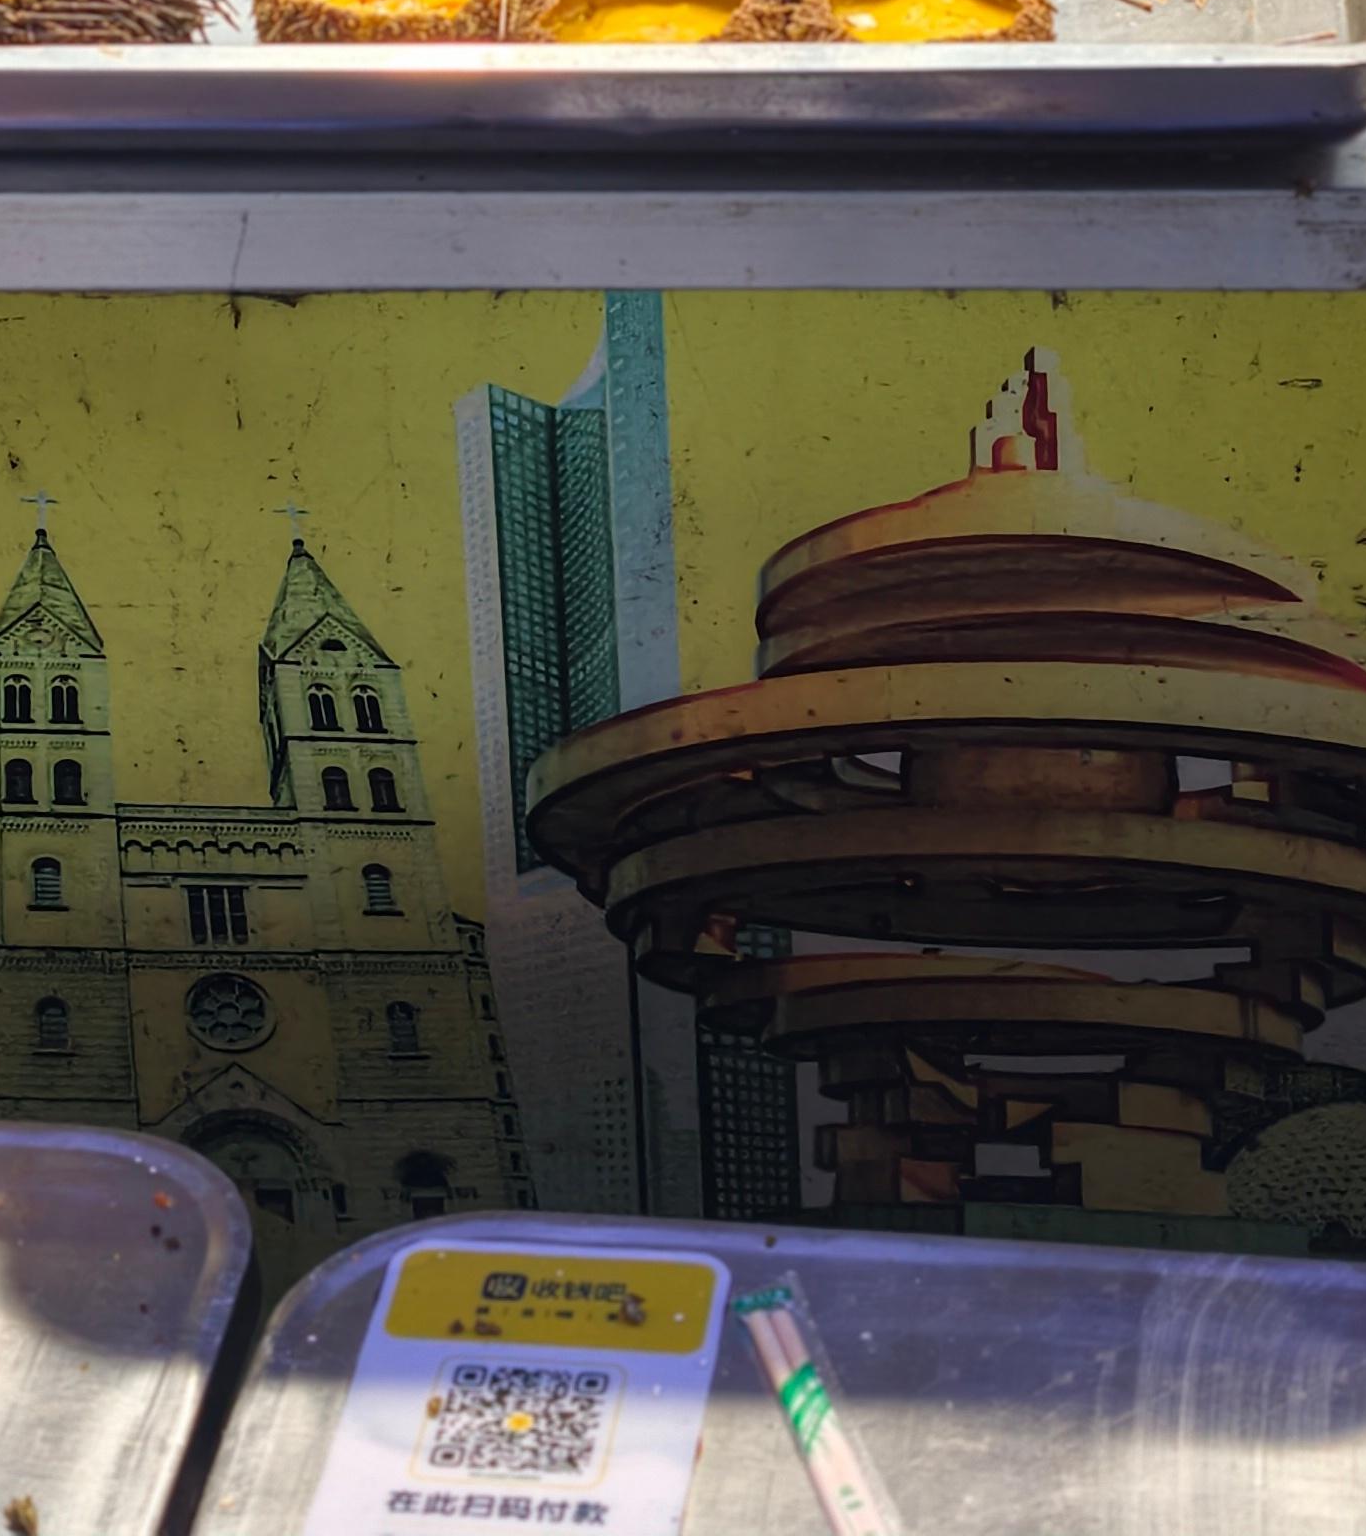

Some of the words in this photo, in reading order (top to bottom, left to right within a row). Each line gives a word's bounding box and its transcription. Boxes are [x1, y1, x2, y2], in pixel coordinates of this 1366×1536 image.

[386, 1489, 610, 1525] 在此扫码付款
